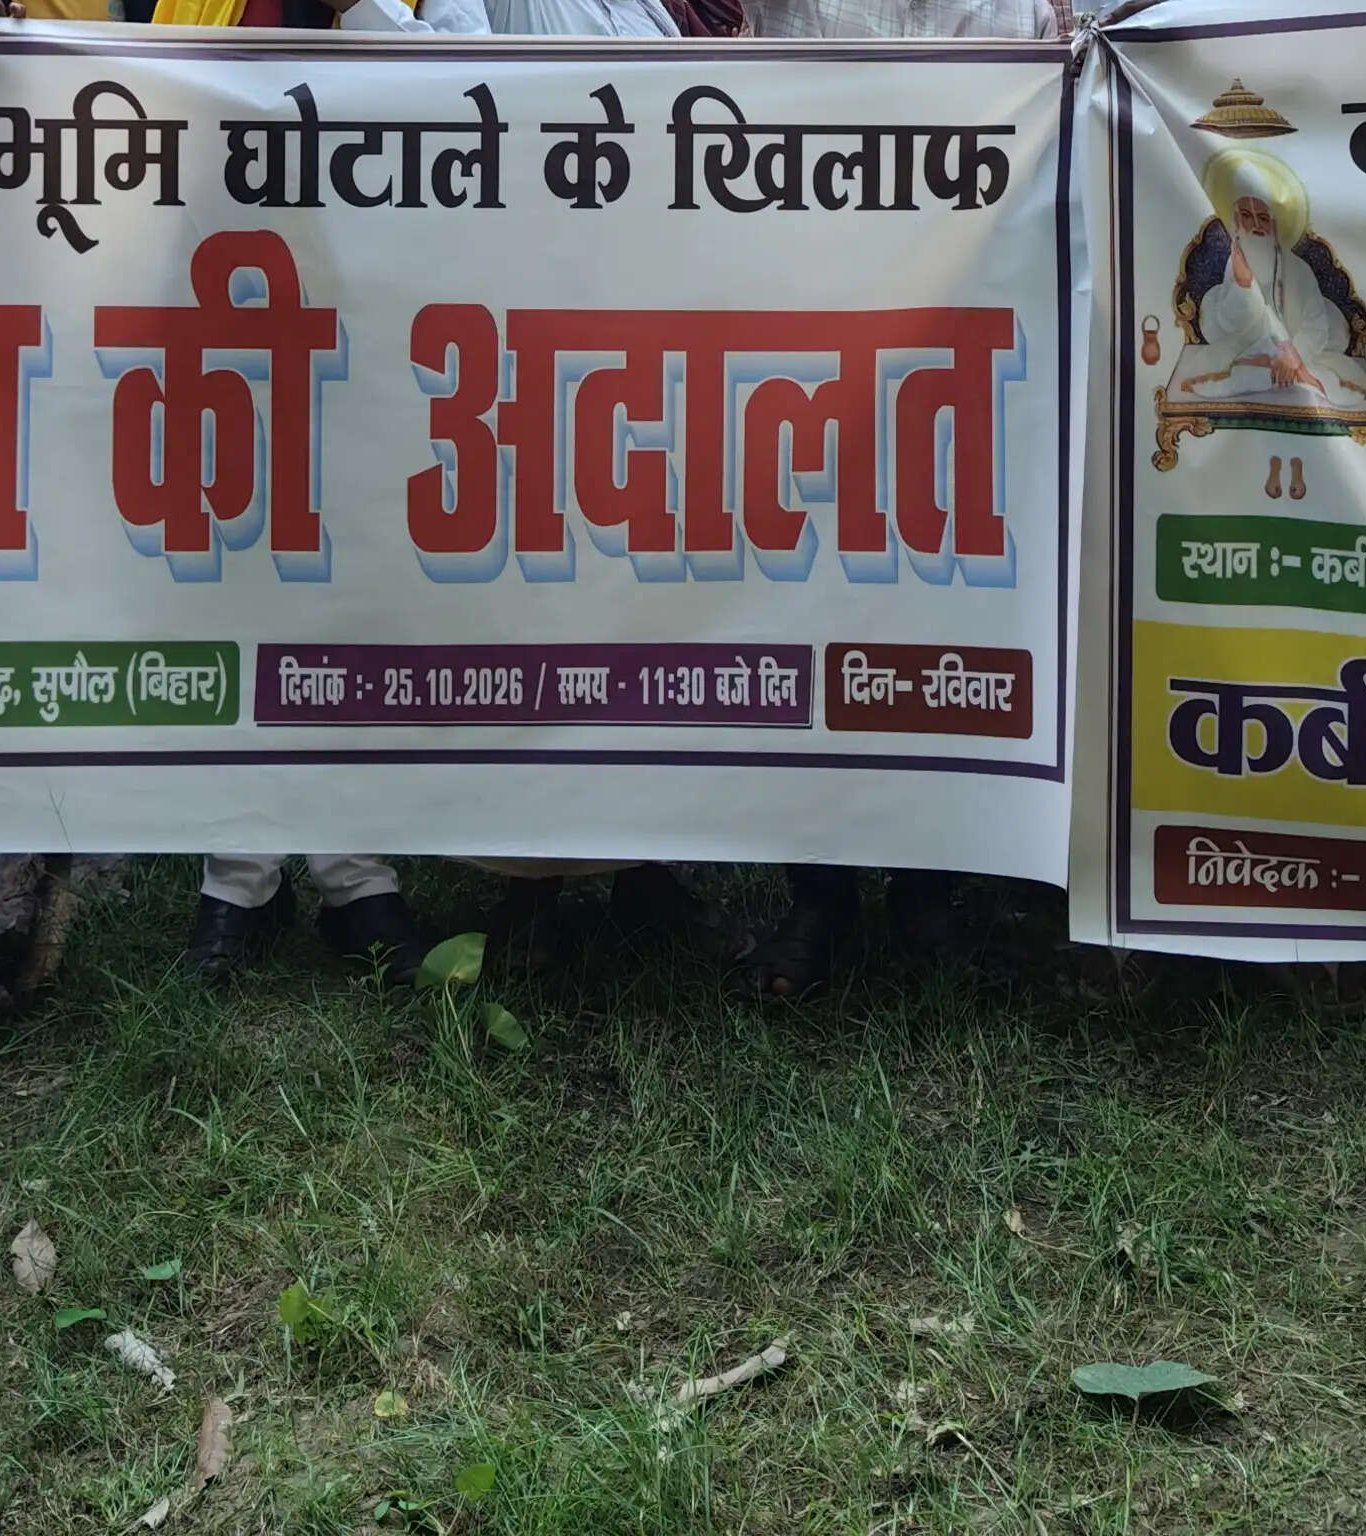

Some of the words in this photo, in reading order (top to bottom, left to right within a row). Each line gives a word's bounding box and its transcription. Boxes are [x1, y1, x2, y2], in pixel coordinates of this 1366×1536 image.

[221, 83, 508, 210] घोटाले
[541, 83, 636, 210] के
[668, 85, 1016, 214] खिलाफ
[94, 229, 343, 569] की
[406, 303, 1020, 572] अदालत
[1181, 540, 1261, 579] स्थान
[31, 651, 119, 723] सुपौल
[125, 650, 227, 716] (बिहार)
[278, 655, 347, 707] दिनांक
[383, 666, 524, 707] 25.10.2026
[556, 666, 611, 705] समय
[638, 665, 705, 707] 11:30
[714, 656, 752, 707] बजे
[758, 655, 798, 707] दिन
[1185, 838, 1321, 893] निवेदक
